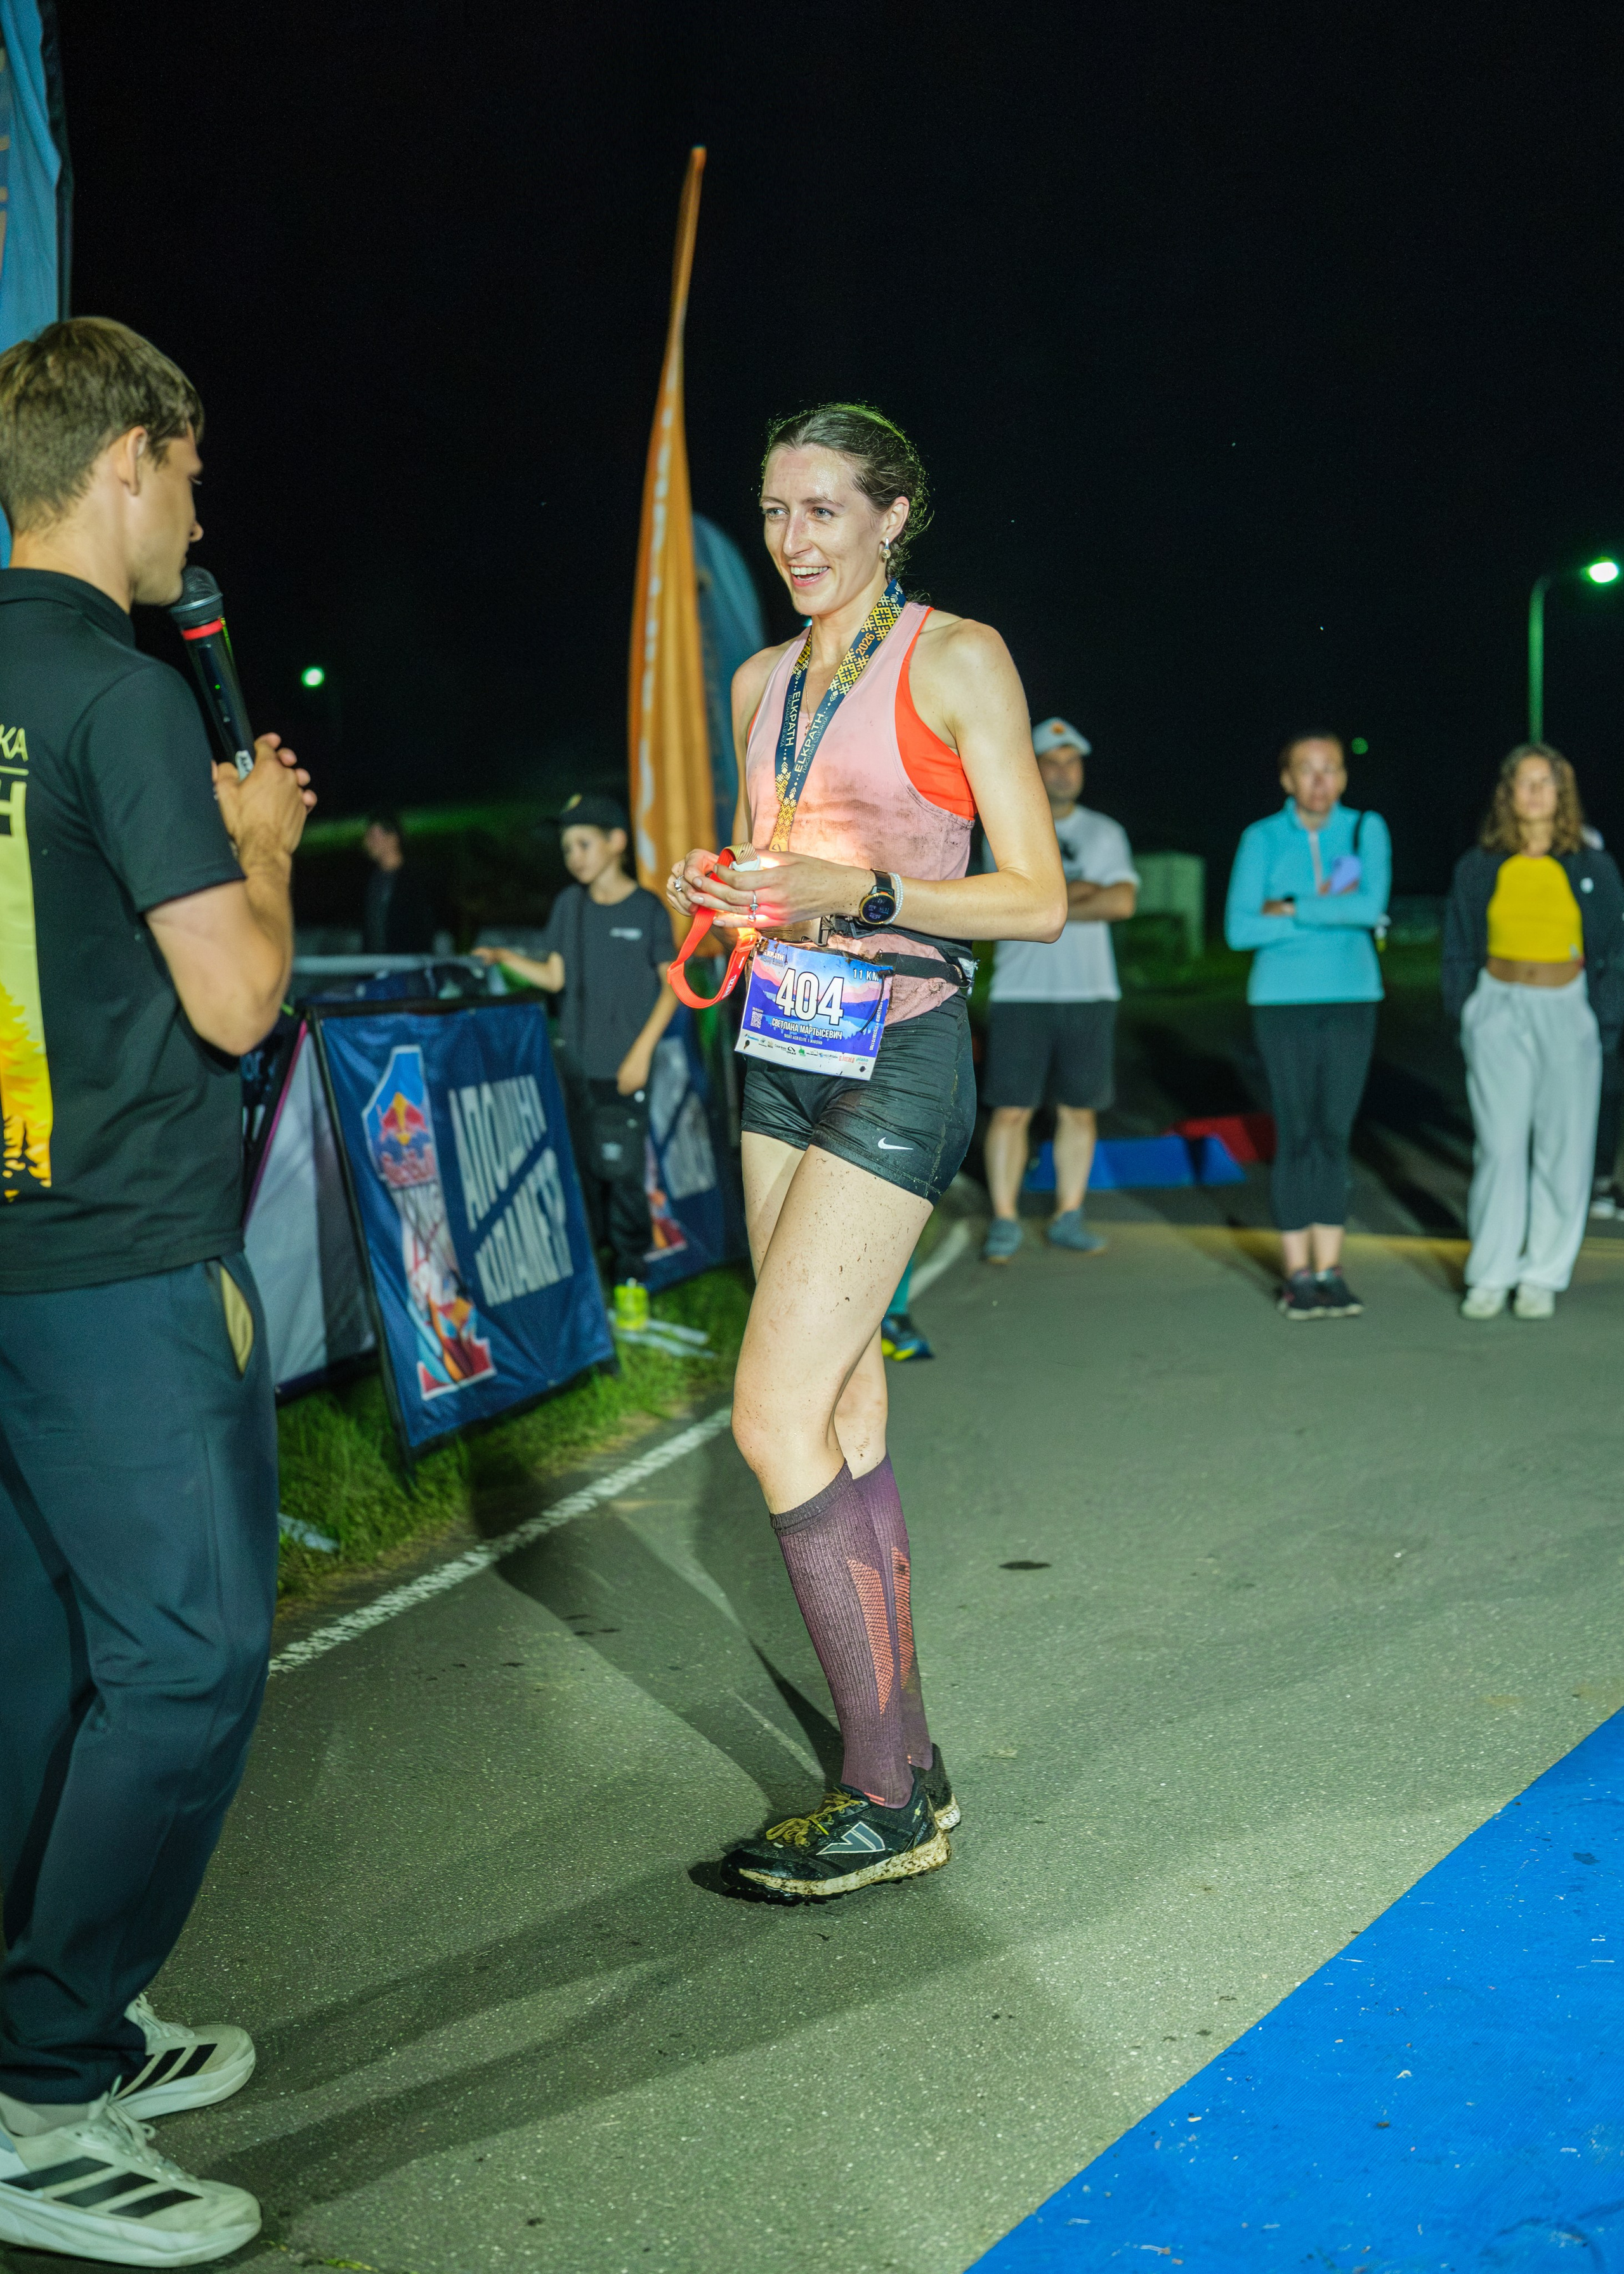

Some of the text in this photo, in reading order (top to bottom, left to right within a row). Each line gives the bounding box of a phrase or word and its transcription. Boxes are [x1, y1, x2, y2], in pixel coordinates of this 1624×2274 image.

[855, 632, 875, 656] 2026
[785, 691, 801, 746] ELKPATH
[794, 713, 824, 773] ELKPATH
[853, 969, 863, 979] 11
[775, 968, 844, 1026] 404
[771, 1017, 842, 1040] СВЕТЛАНА МАРТЫСЕВИЧ
